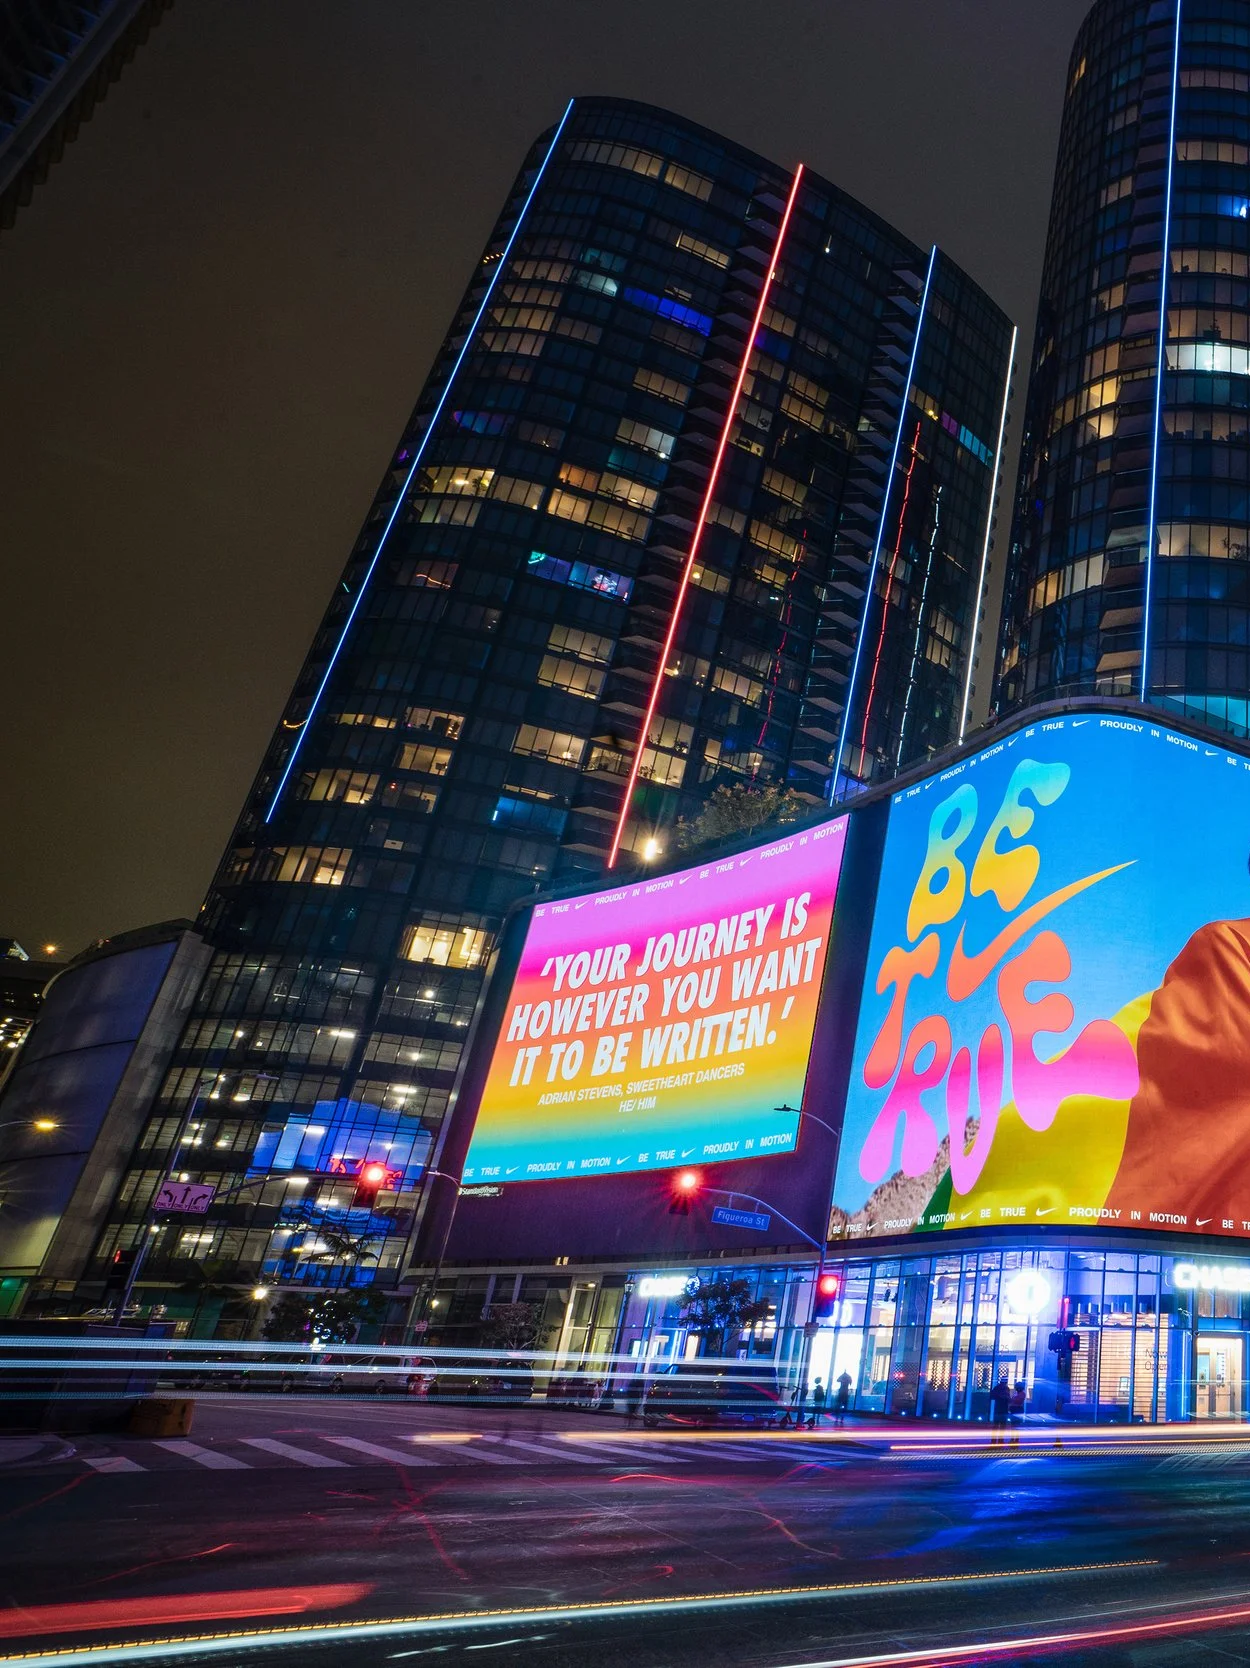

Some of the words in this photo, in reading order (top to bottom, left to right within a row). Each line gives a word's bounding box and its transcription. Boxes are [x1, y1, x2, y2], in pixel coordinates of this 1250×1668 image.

[1025, 728, 1035, 738] BE
[1042, 721, 1065, 732] TRUE
[1100, 719, 1144, 733] PROUDLY
[1151, 729, 1160, 738] IN
[1166, 734, 1199, 752] MOTION
[1227, 756, 1238, 766] BE
[894, 795, 903, 804] BE
[906, 787, 921, 799] TRUE
[940, 764, 967, 783] PROUDLY
[970, 758, 977, 768] IN
[980, 744, 1005, 763] MOTION
[535, 908, 546, 917] BE
[551, 903, 570, 914] TRUE
[594, 891, 628, 906] PROUDLY
[632, 888, 640, 898] IN
[645, 879, 674, 894] MOTION
[699, 869, 710, 880] BE
[715, 861, 735, 875] TRUE
[760, 841, 795, 861] PROUDLY
[799, 836, 808, 847] IN
[813, 822, 844, 841] MOTION
[906, 758, 1071, 943] BE
[635, 909, 770, 975] JOURNEY
[780, 891, 812, 939] IS
[506, 983, 650, 1043] HOWEVER
[660, 966, 722, 1018] YOU
[731, 937, 823, 1000] WANT
[509, 1043, 543, 1088] IT
[546, 1039, 584, 1083] TO
[591, 1032, 630, 1077] BE
[538, 1089, 576, 1106] ADRIAN
[577, 1084, 624, 1103] STEVENS,
[625, 1071, 695, 1096] SWEETHEART
[696, 1062, 745, 1085] DANCERS
[858, 930, 1140, 1196] TRUE
[639, 1097, 656, 1110] HIM
[463, 1168, 474, 1177] BE
[481, 1166, 501, 1176] TRUE
[526, 1161, 562, 1173] PROUDLY
[566, 1160, 575, 1170] IN
[580, 1157, 612, 1169] MOTION
[638, 1153, 649, 1163] BE
[655, 1149, 676, 1161] TRUE
[703, 1140, 740, 1156] PROUDLY
[745, 1138, 754, 1149] IN
[759, 1132, 793, 1148] MOTION
[718, 1211, 753, 1223] Figueroa
[756, 1216, 765, 1226] St
[832, 1224, 841, 1234] BE
[846, 1222, 862, 1233] TRUE
[884, 1216, 913, 1229] PROUDLY
[917, 1215, 925, 1226] IN
[929, 1212, 956, 1225] MOTION
[980, 1208, 991, 1218] BE
[1000, 1206, 1026, 1217] TRUE
[1068, 1207, 1122, 1220] PROUDLY
[1130, 1210, 1141, 1220] IN
[1149, 1212, 1187, 1225] MOTION
[1222, 1219, 1234, 1229] BE
